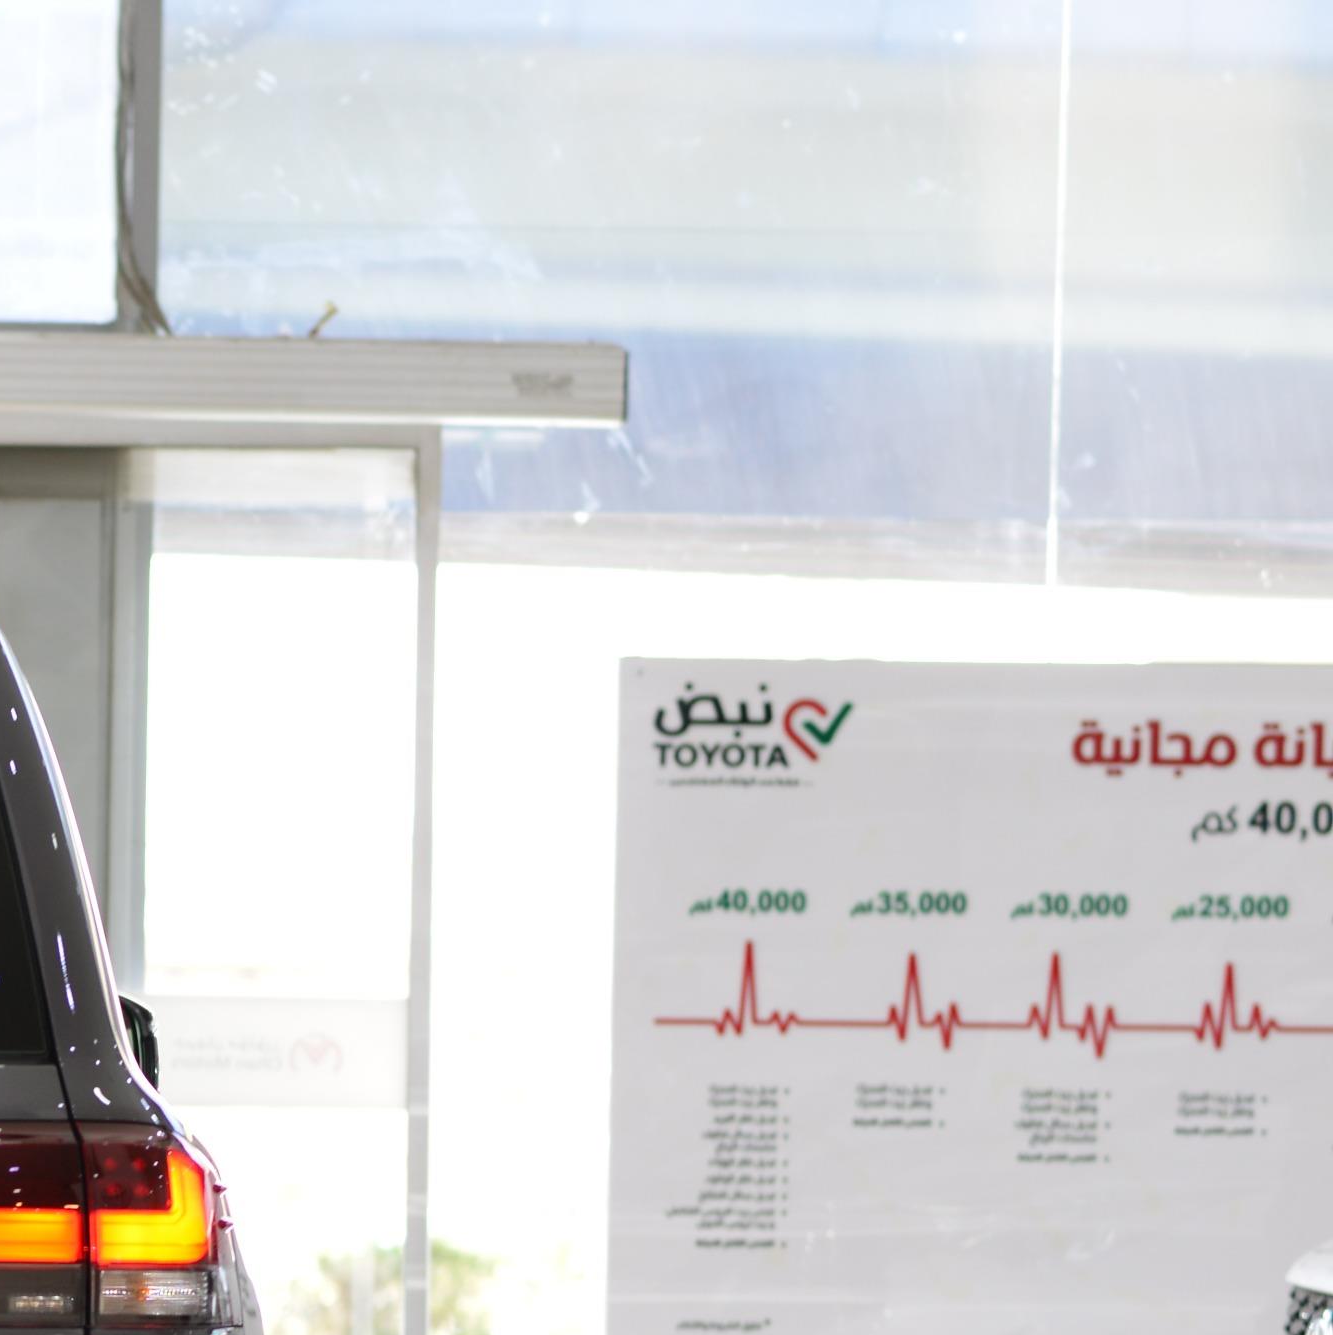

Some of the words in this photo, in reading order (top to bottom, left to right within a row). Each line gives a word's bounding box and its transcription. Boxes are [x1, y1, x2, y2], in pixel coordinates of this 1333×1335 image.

[655, 682, 773, 738] نبض
[654, 742, 789, 768] TOYOTA
[1072, 719, 1238, 778] مجانية
